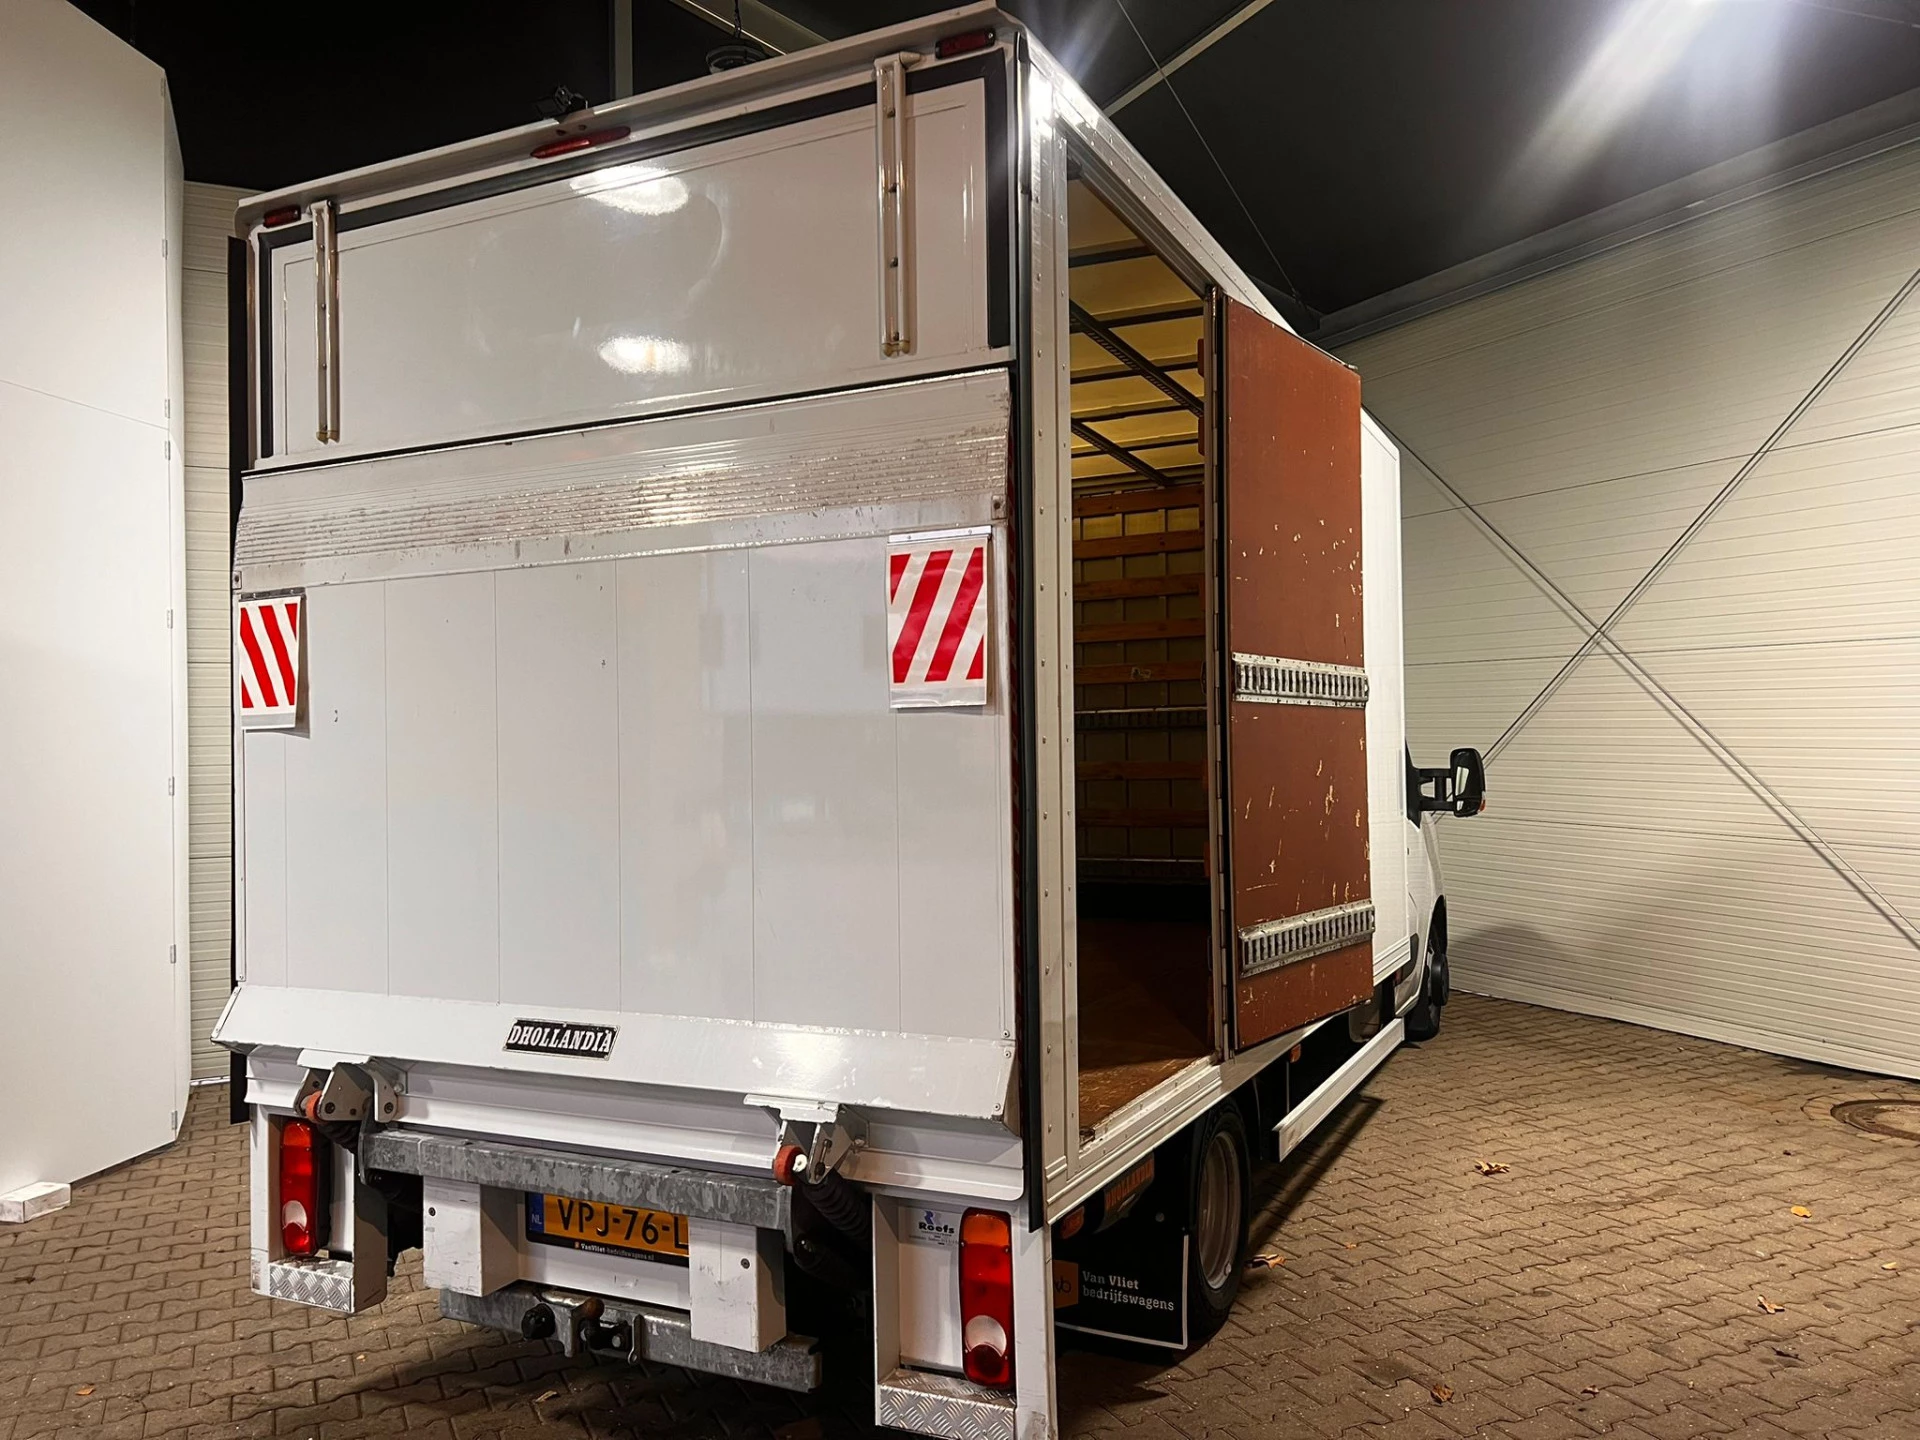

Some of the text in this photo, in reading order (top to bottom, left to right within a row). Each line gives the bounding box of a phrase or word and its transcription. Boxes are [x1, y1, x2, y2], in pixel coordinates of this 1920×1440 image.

[507, 1025, 613, 1053] DHOLLANDIA
[531, 1213, 542, 1225] NL
[557, 1198, 689, 1250] VPJ-76-L
[1082, 1270, 1139, 1290] Van Vliet
[1082, 1285, 1175, 1311] bedrijfswagens
